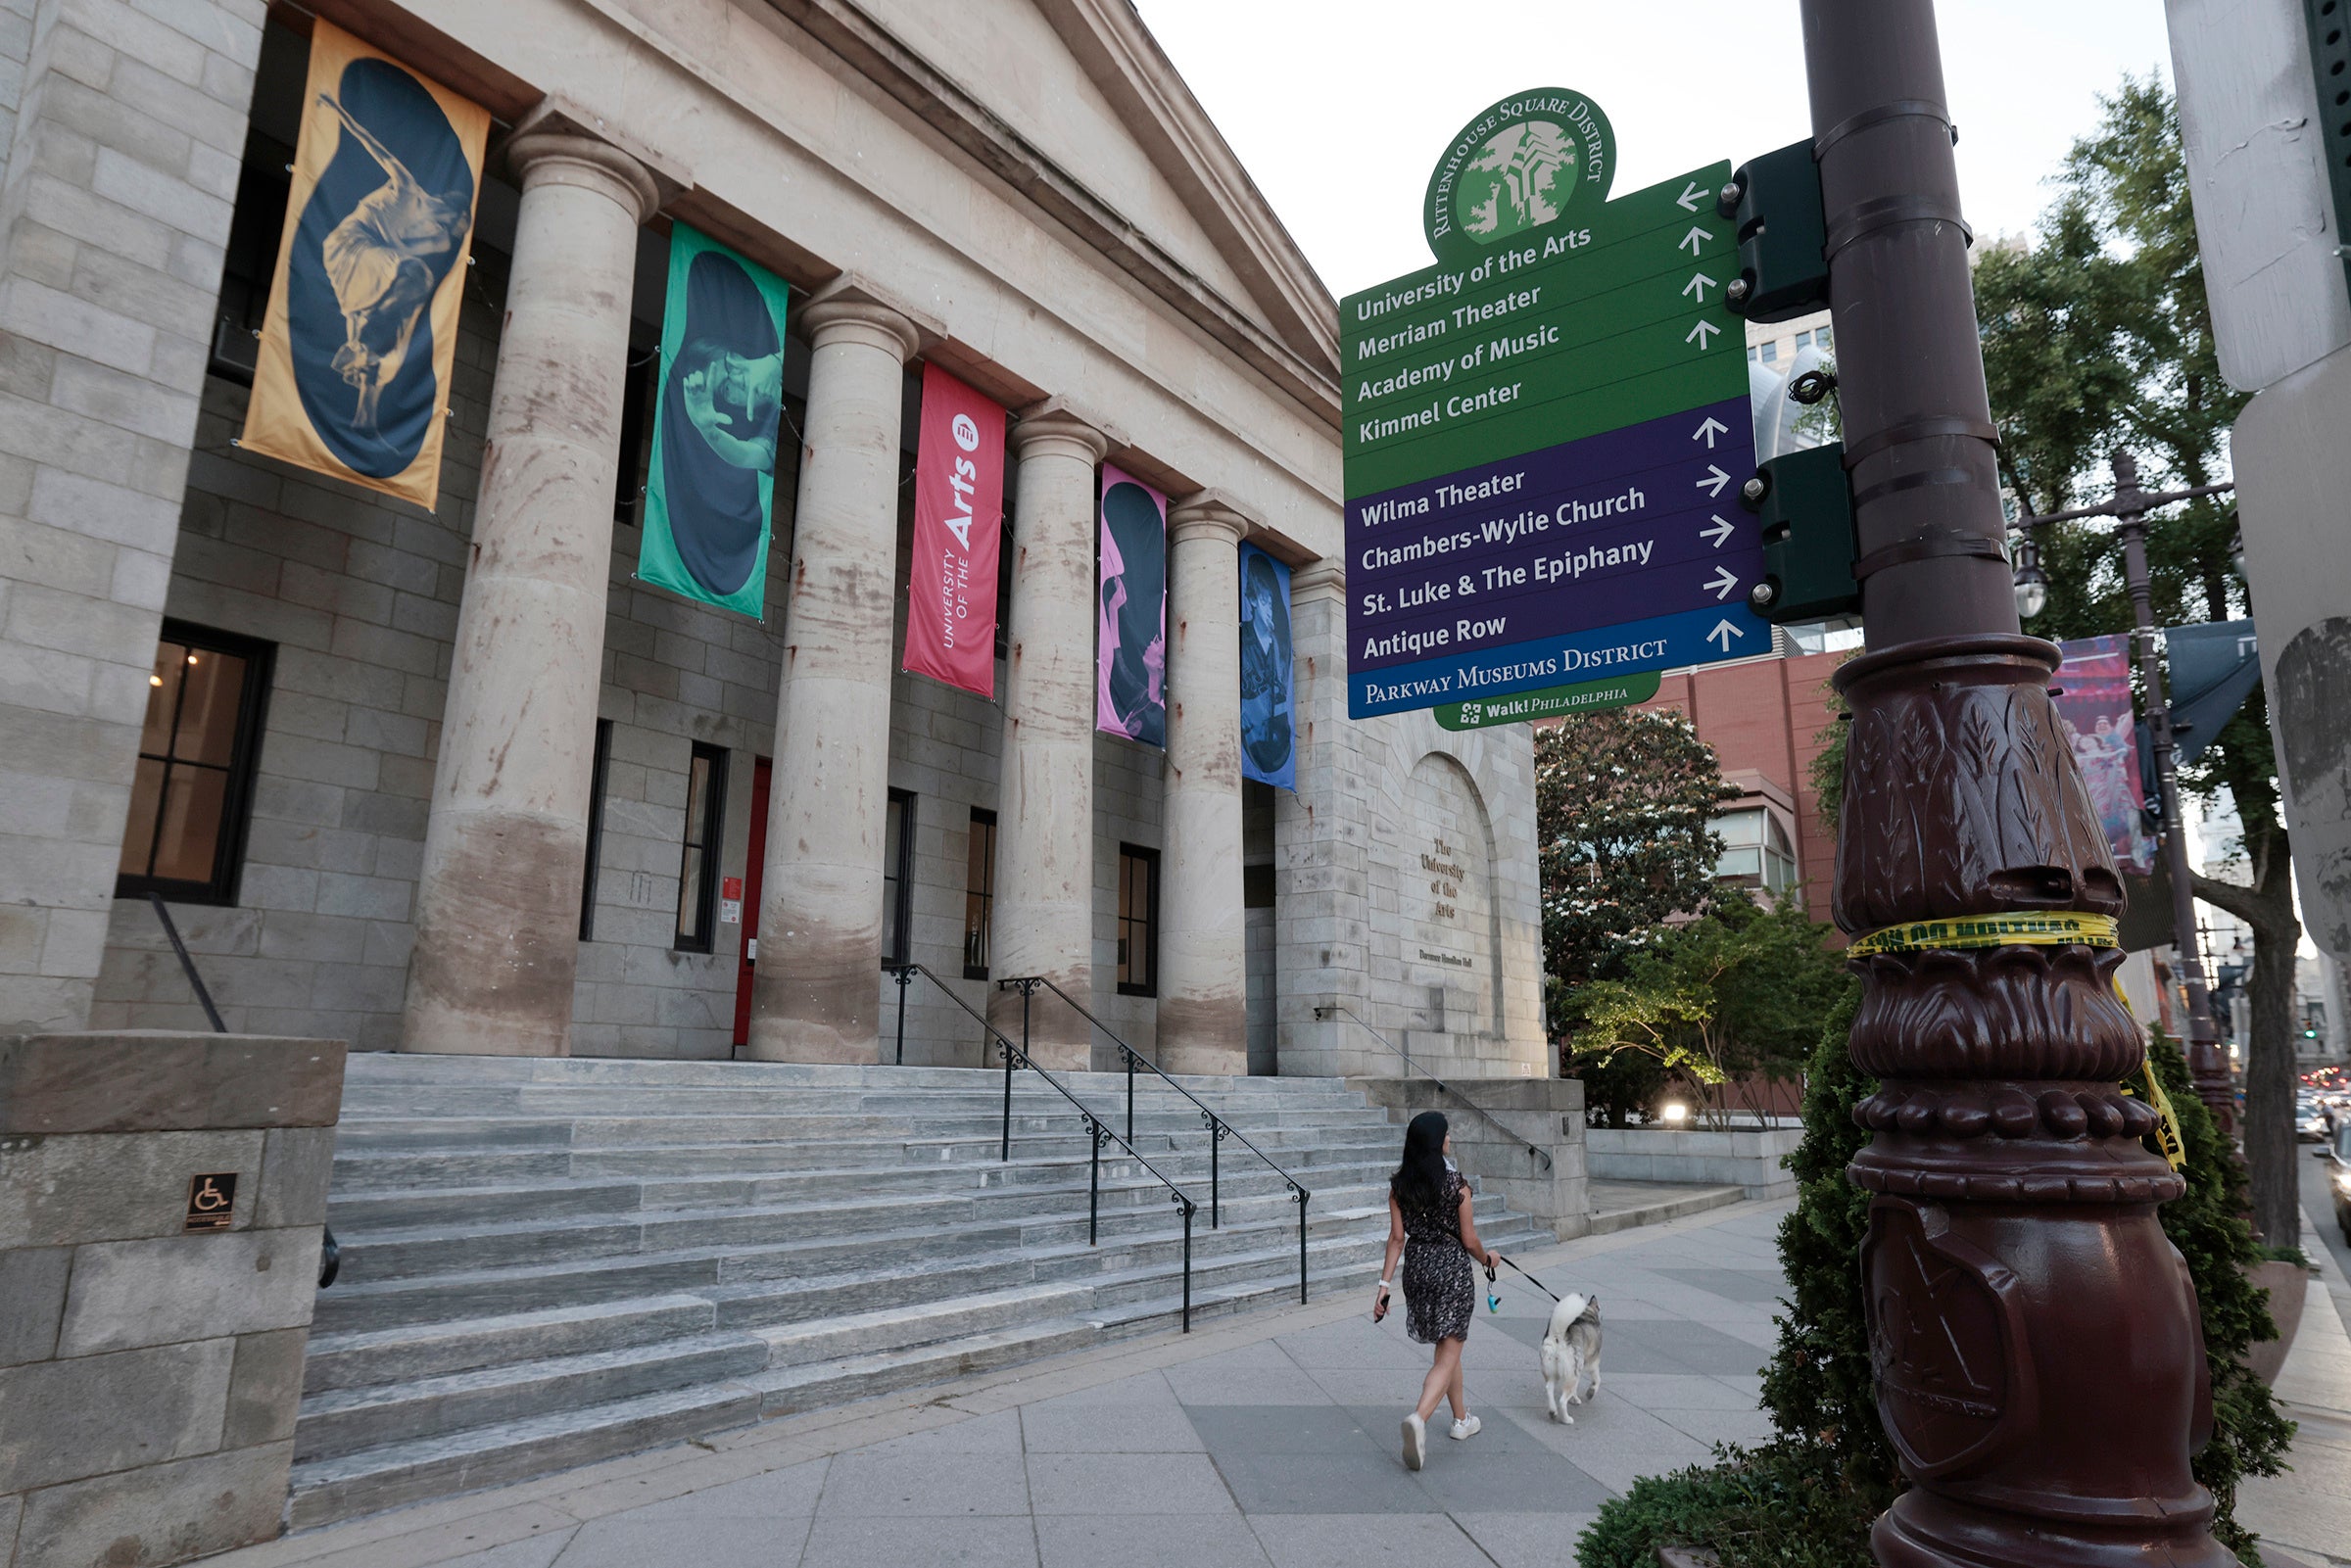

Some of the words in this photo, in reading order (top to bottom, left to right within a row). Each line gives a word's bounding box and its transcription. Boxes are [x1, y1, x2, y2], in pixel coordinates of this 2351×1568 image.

[1433, 115, 1497, 240] RITTENHOUSE
[1500, 97, 1569, 121] SQUARE
[1567, 100, 1604, 183] DISTRICT
[1357, 272, 1464, 321] University
[1470, 260, 1493, 283] of
[1499, 245, 1536, 273] the
[1542, 227, 1592, 261] Arts
[1358, 320, 1446, 360] Merriam
[1452, 287, 1541, 330] Theater
[1358, 358, 1455, 402] Academy
[1461, 345, 1483, 369] of
[1490, 325, 1559, 361] Music
[1360, 403, 1440, 443] Kimmel
[1447, 380, 1522, 417] Center
[943, 455, 977, 552] Arts
[1361, 498, 1429, 527] Wilma
[1435, 471, 1524, 509] Theater
[1362, 511, 1550, 571] Chambers-Wylie
[1556, 488, 1646, 526] Church
[943, 548, 956, 648] UNIVERSITY
[957, 559, 969, 590] THE
[1363, 593, 1392, 616] St.
[1399, 582, 1451, 609] Luke
[1458, 576, 1476, 595] &
[1482, 565, 1526, 591] The
[1534, 540, 1654, 584] Epiphany
[956, 594, 968, 619] OF
[1363, 629, 1449, 659] Antique
[1457, 617, 1507, 641] Row
[1365, 675, 1452, 704] PARKWAY
[1457, 658, 1557, 689] MUSEUMS
[1563, 640, 1667, 672] DISTRICT
[1486, 699, 1529, 718] Walk!
[1531, 688, 1628, 712] PHILADELPHIA
[1421, 854, 1464, 882] University
[1433, 837, 1452, 857] The
[1431, 879, 1441, 894] of
[1443, 881, 1458, 898] the
[1435, 901, 1455, 919] Arts
